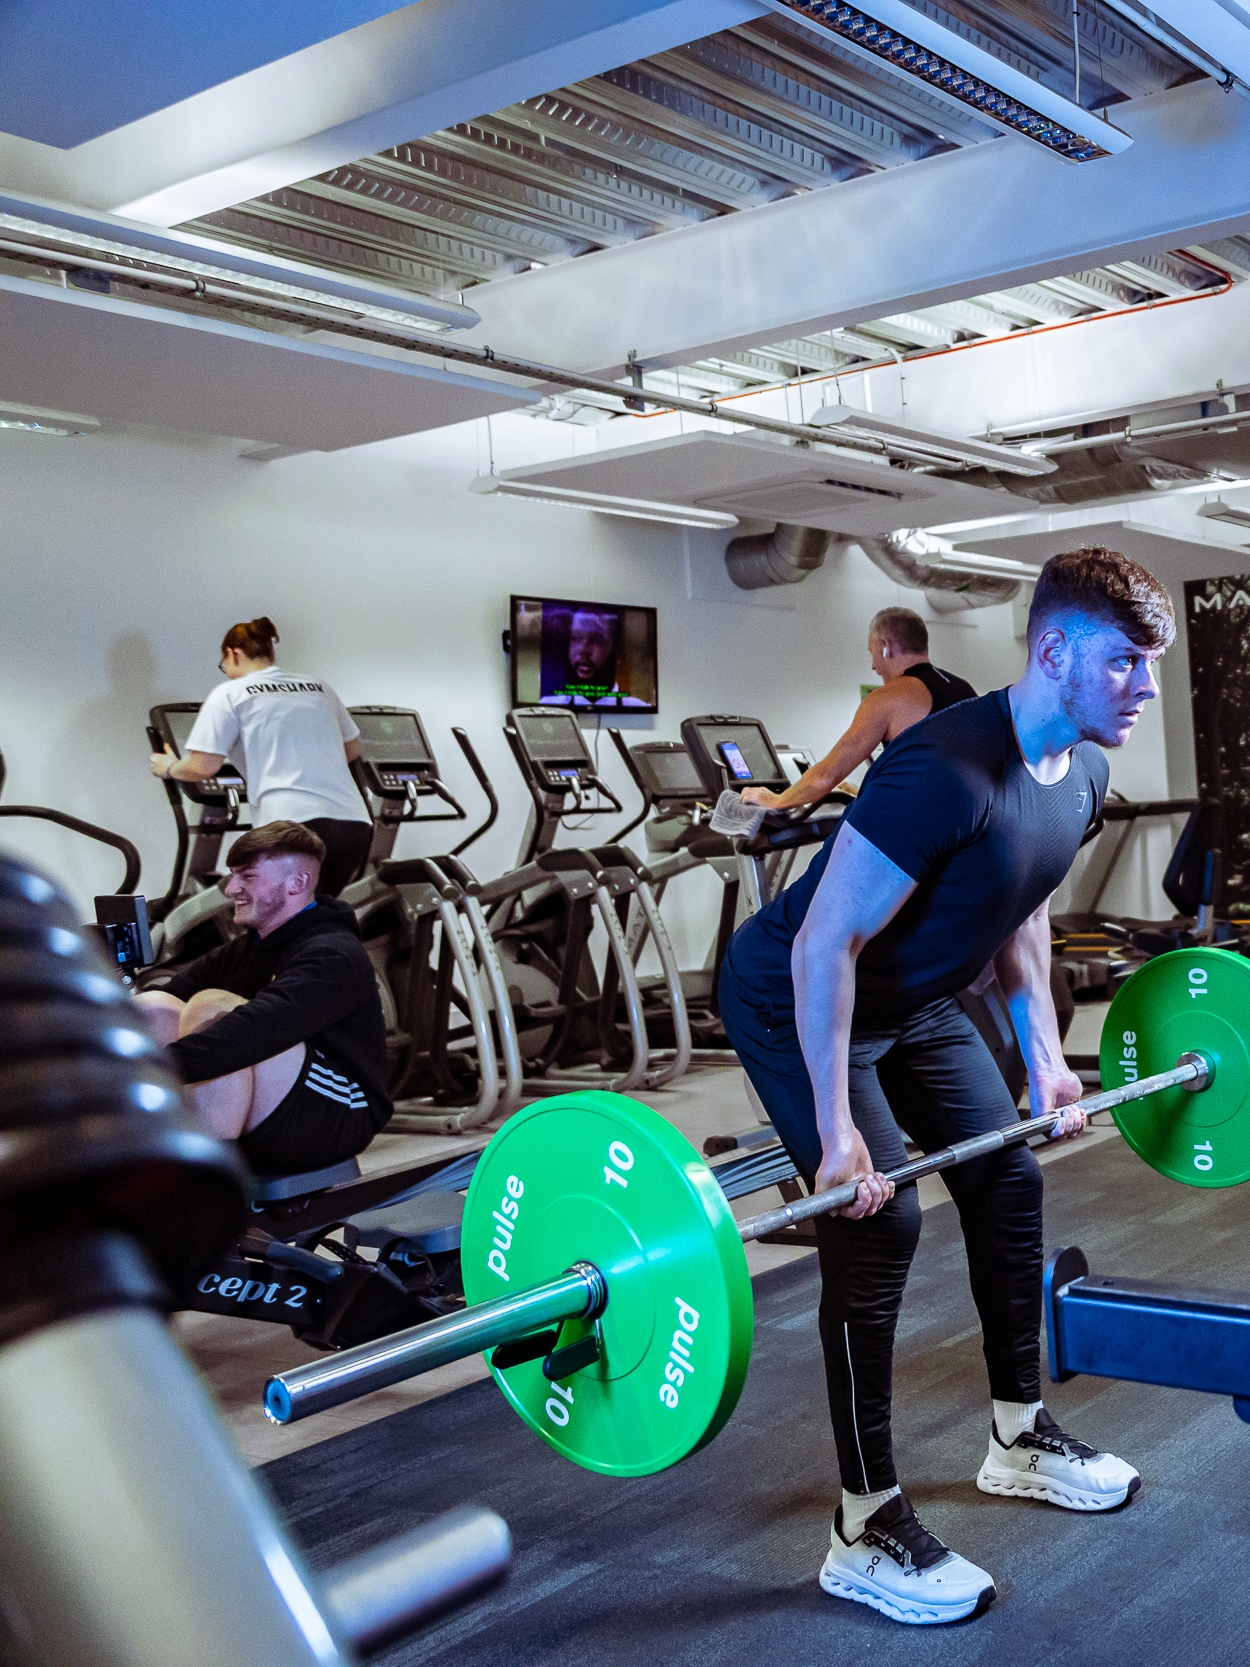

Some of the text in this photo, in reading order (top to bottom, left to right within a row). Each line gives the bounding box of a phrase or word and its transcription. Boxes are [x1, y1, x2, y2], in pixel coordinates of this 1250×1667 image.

[1187, 967, 1208, 999] 10
[1119, 1030, 1138, 1083] ulse
[603, 1140, 635, 1189] 10
[1193, 1140, 1214, 1171] 10
[487, 1174, 525, 1282] pulse
[197, 1273, 308, 1308] cept 2
[659, 1296, 700, 1410] pulse
[545, 1380, 575, 1428] 10
